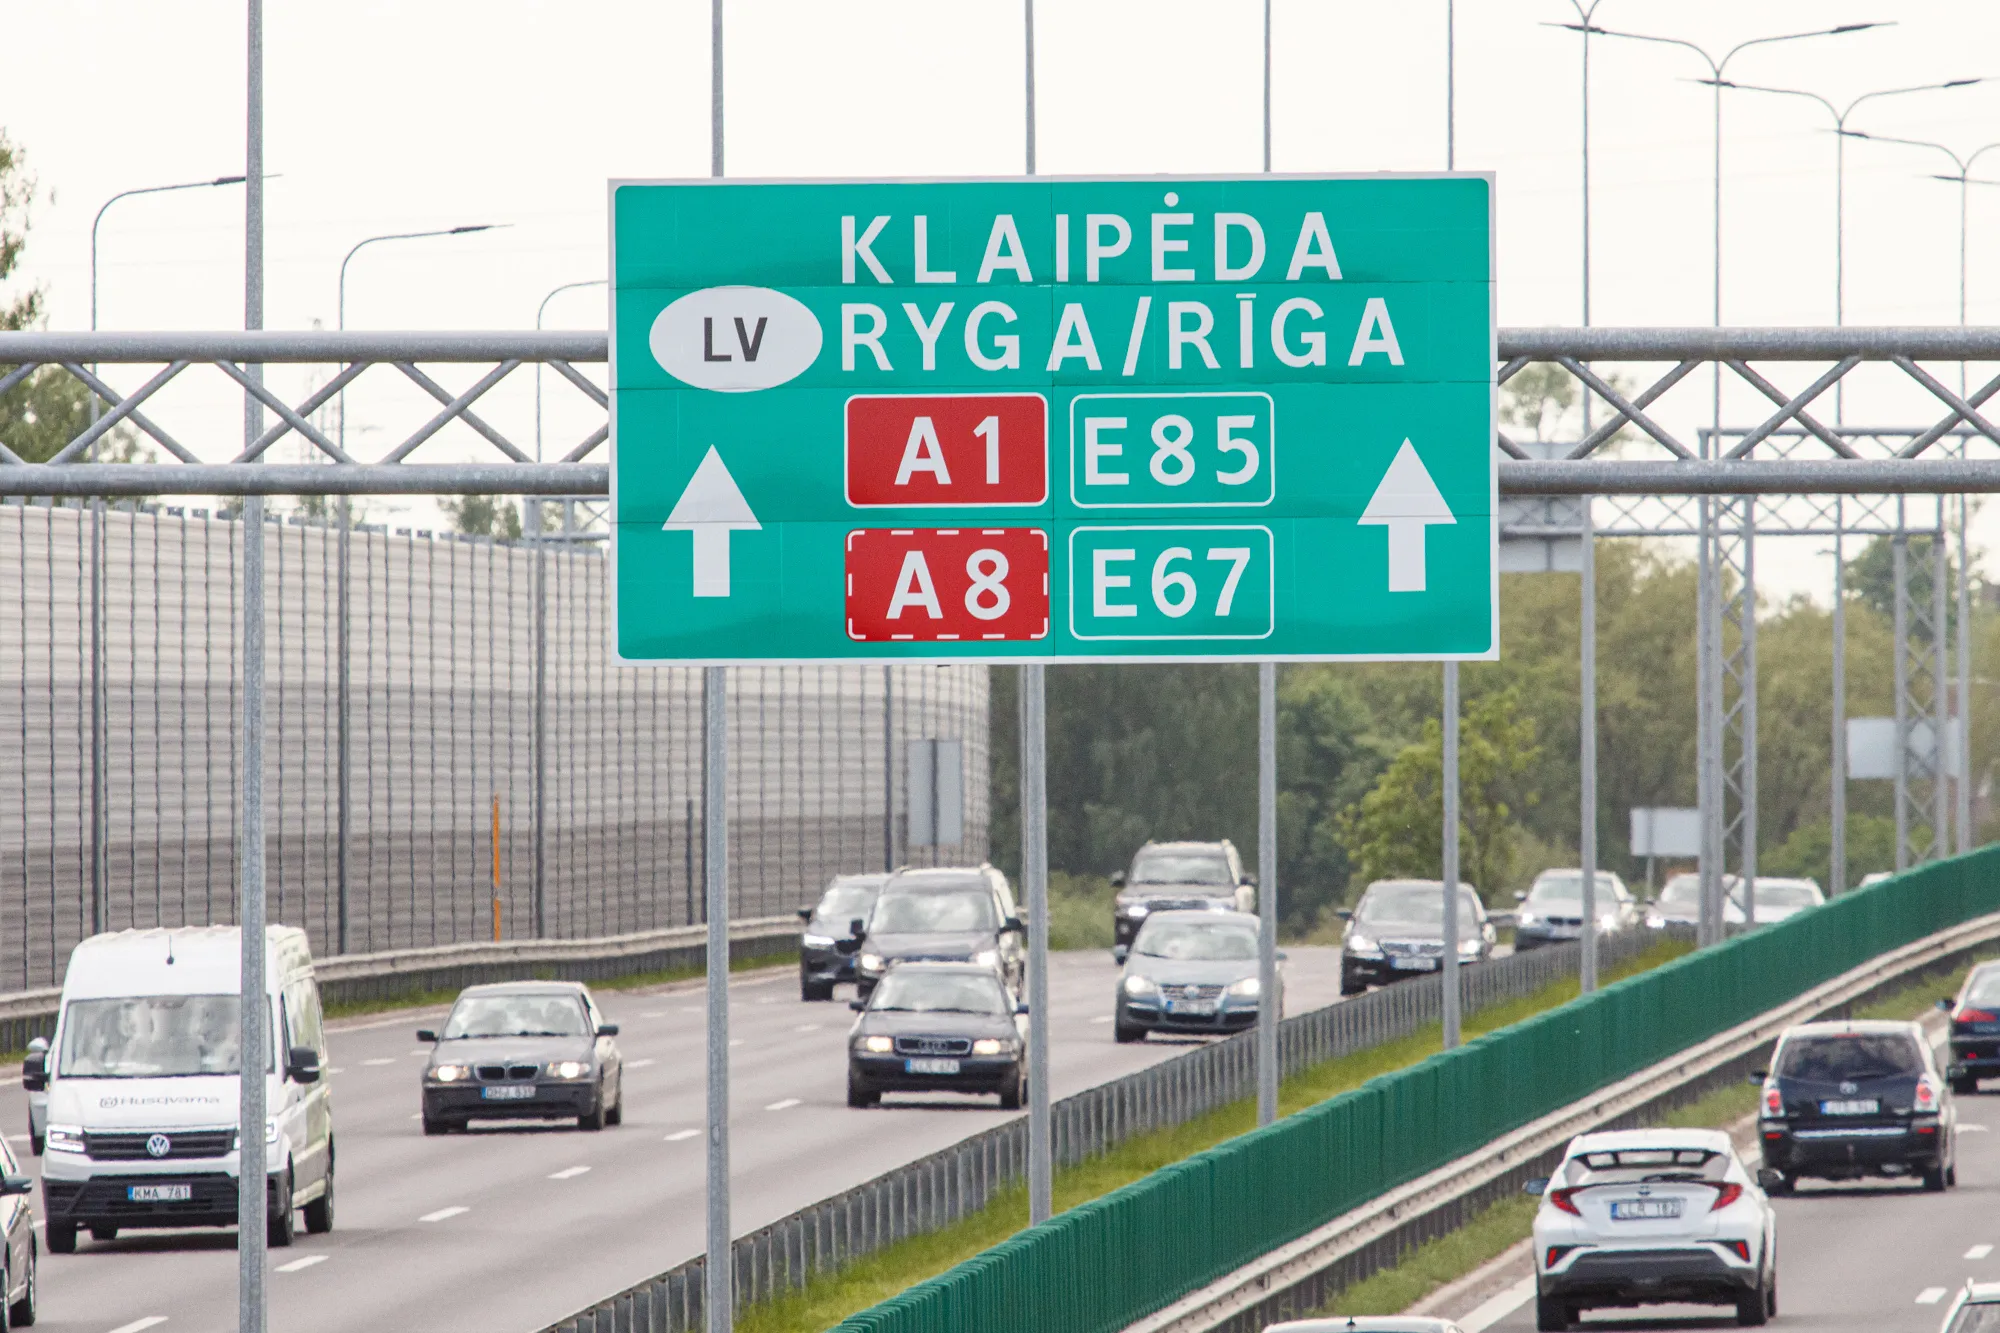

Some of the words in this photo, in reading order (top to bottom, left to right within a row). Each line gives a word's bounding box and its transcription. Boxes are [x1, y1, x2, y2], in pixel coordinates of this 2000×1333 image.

[841, 192, 1343, 284] KLAIPĖDA
[704, 317, 768, 362] LV
[841, 293, 1405, 376] RYGA/RĪGA
[894, 415, 1000, 485] A1
[1084, 414, 1260, 486] E85
[886, 548, 1011, 621] A8
[1093, 547, 1251, 618] E67
[120, 1096, 220, 1106] Husqvarna
[134, 1187, 159, 1199] KMA
